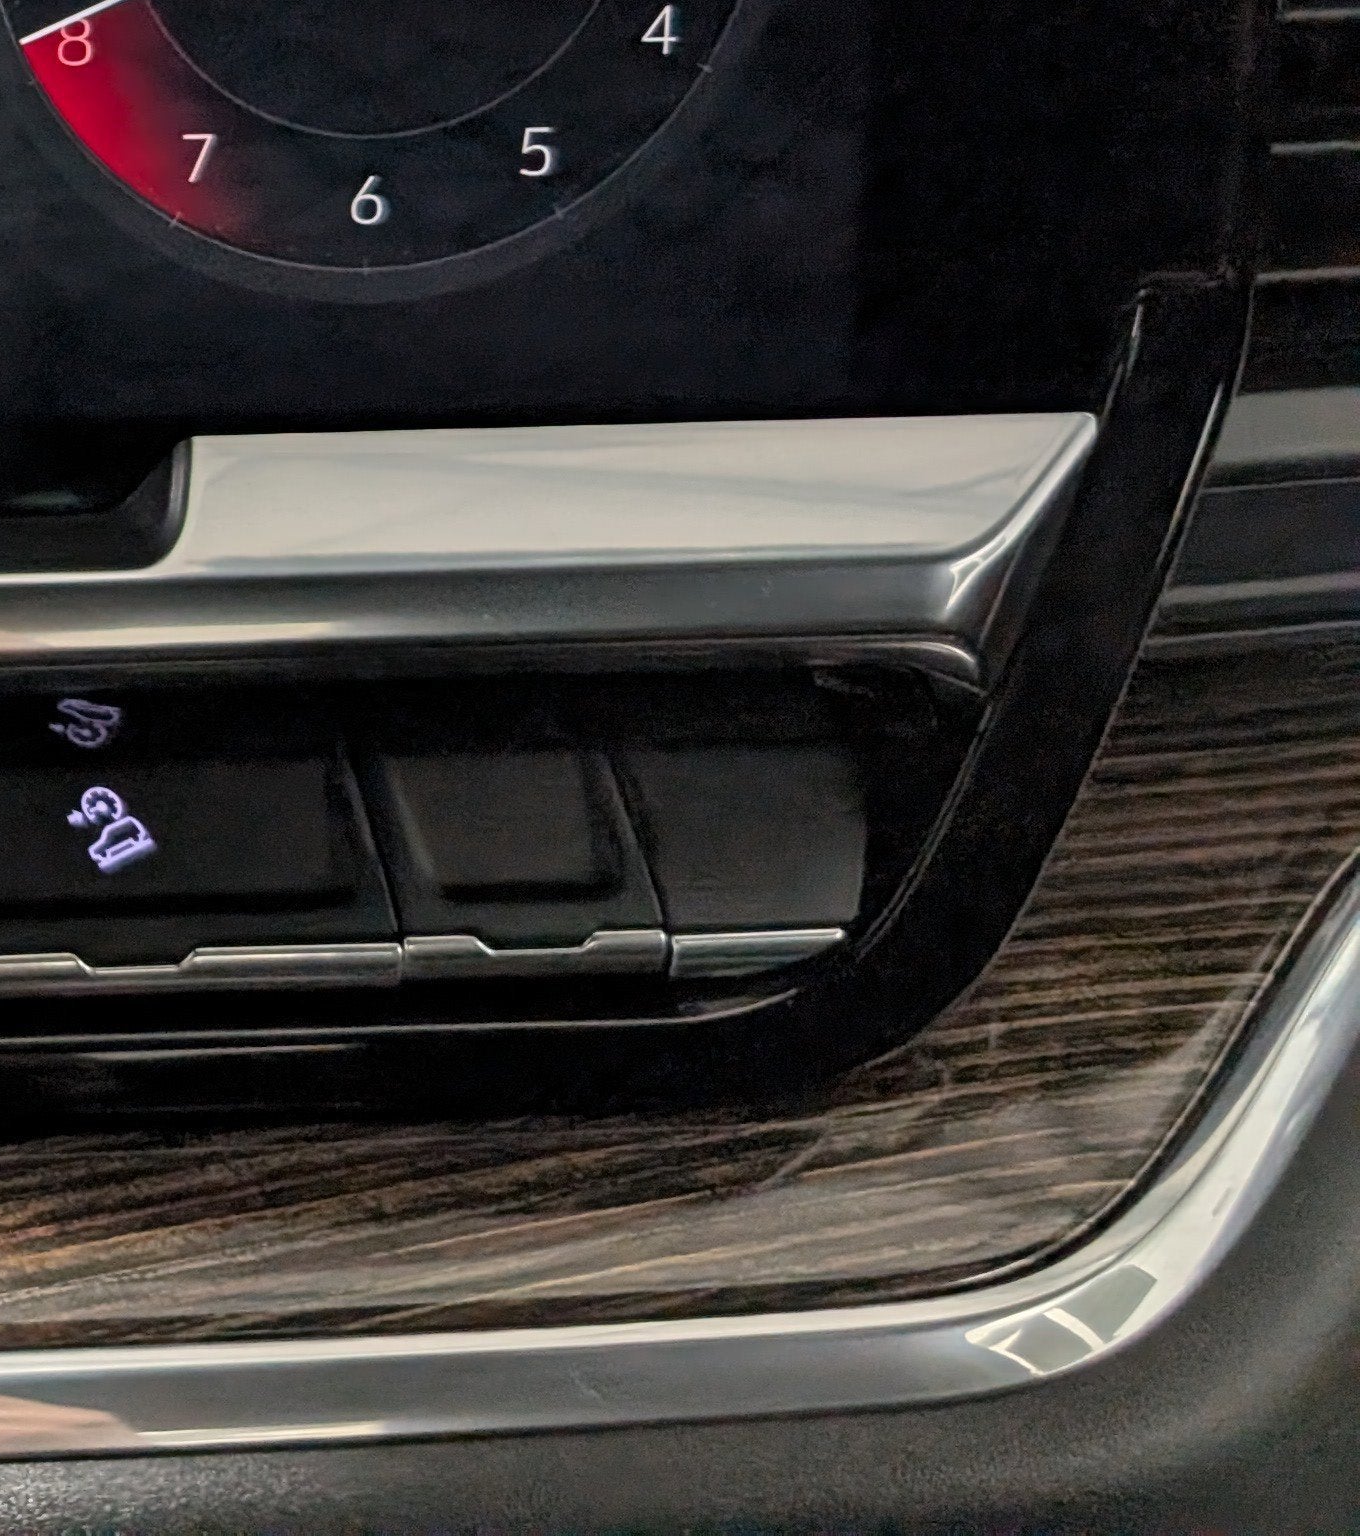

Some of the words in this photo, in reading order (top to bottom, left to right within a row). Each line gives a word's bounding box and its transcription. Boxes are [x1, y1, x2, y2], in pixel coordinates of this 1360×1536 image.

[56, 22, 95, 67] 8
[641, 4, 679, 55] 4
[182, 132, 218, 184] 7
[519, 126, 553, 177] 5
[350, 175, 385, 225] 6
